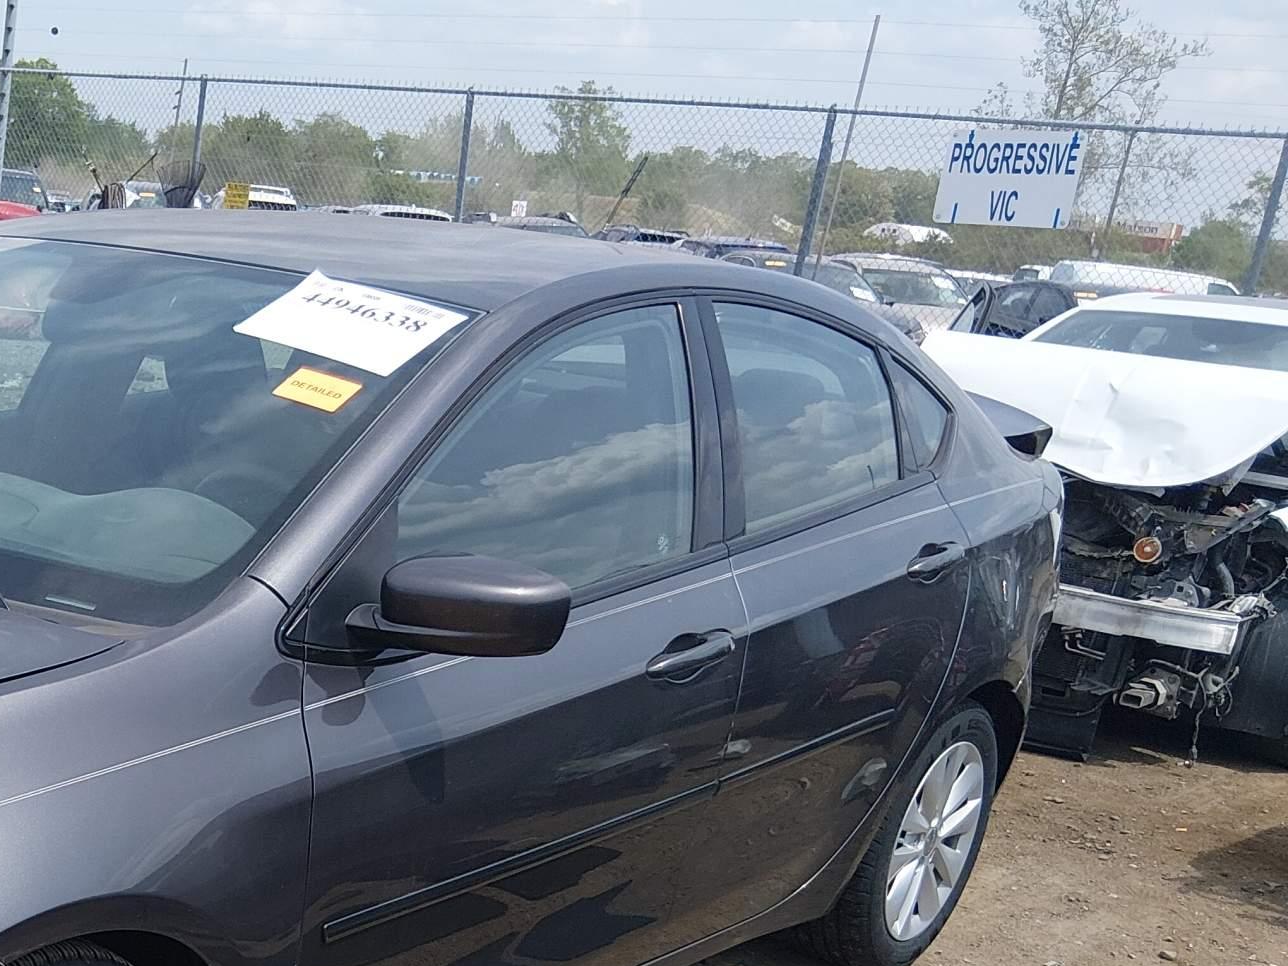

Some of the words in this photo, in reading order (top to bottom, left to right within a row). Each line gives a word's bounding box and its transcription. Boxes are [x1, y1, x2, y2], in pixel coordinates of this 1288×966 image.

[948, 142, 1081, 175] PROGRESSIVE
[989, 190, 1019, 222] VIC
[301, 291, 428, 333] 44946338
[289, 379, 343, 400] DETAILED
